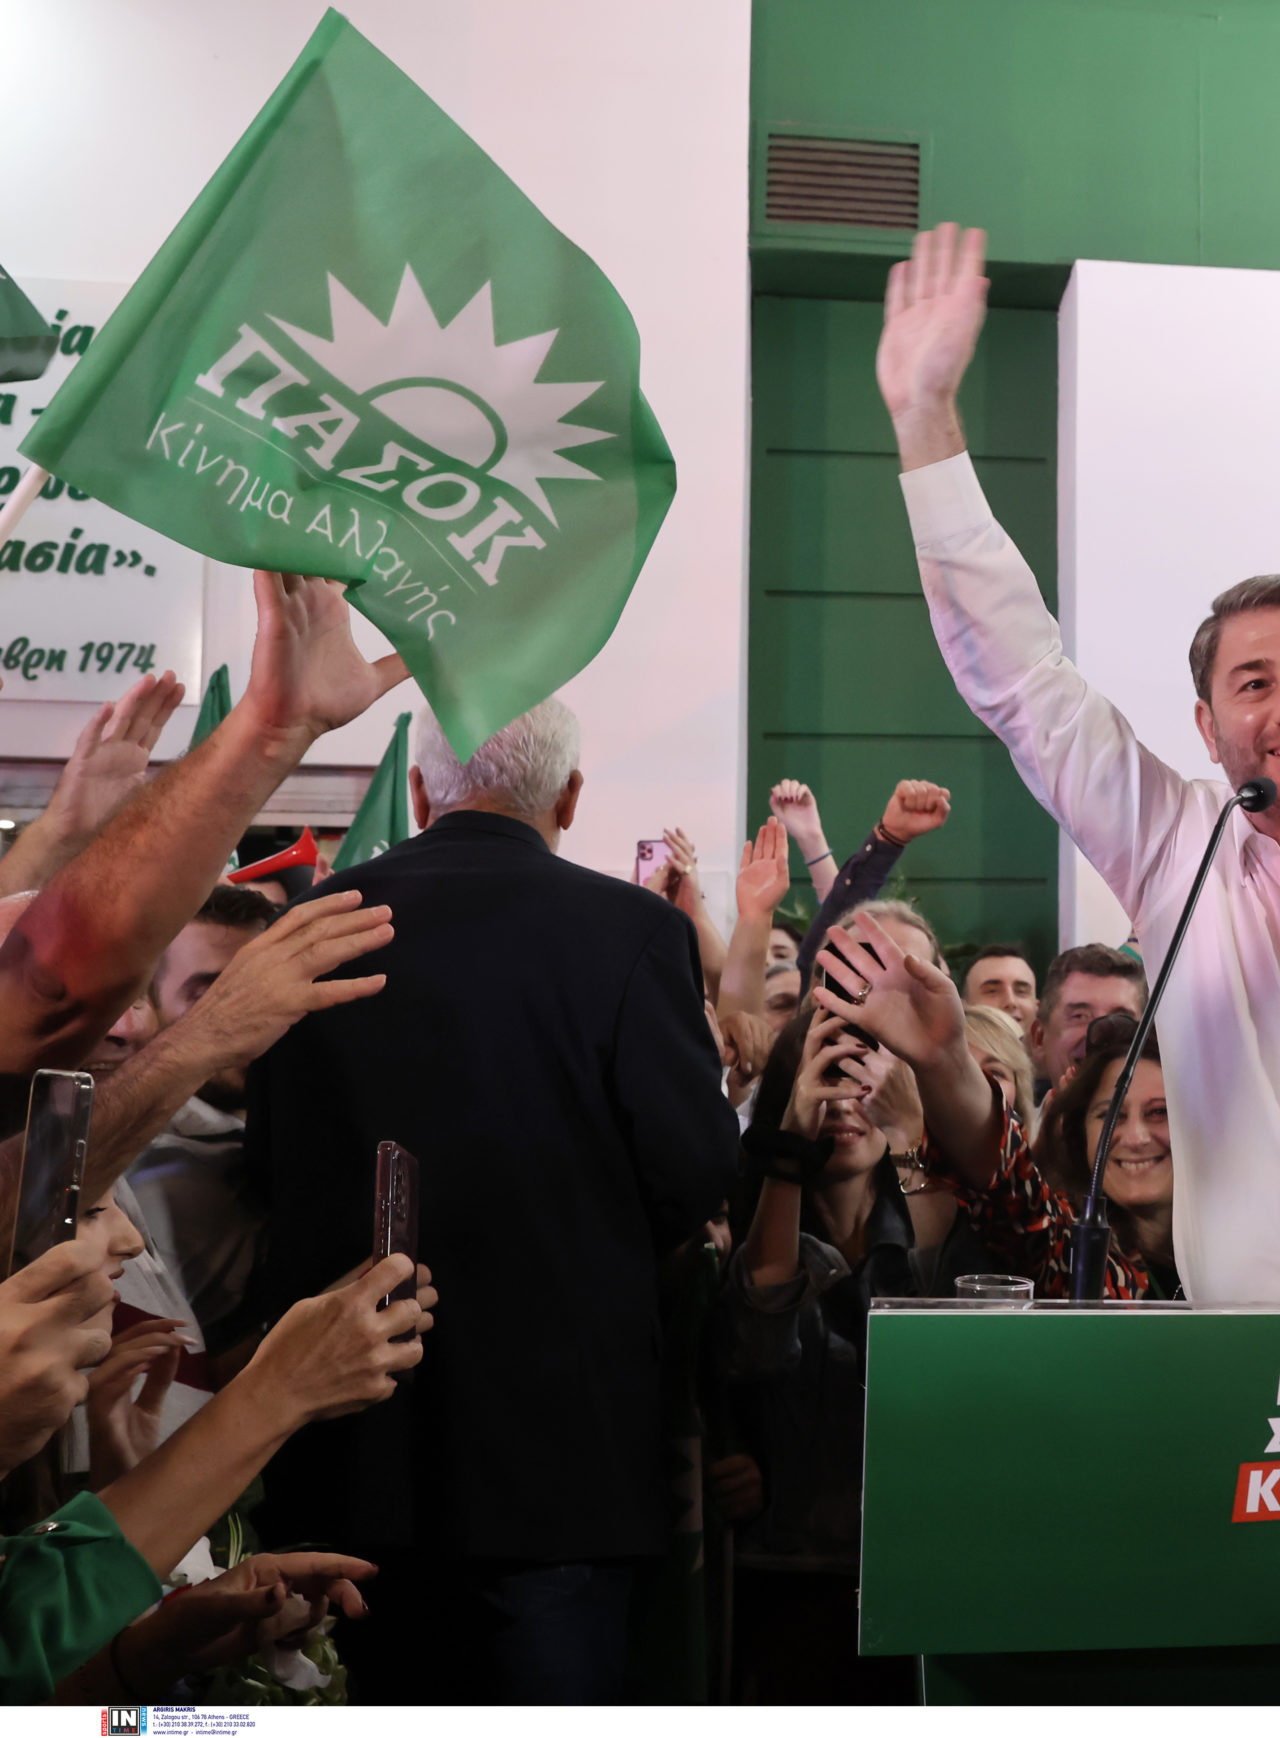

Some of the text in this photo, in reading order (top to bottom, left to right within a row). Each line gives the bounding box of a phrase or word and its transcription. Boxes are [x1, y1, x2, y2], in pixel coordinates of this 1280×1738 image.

[146, 411, 295, 525] Κίνημα
[194, 322, 547, 587] ΠΑΣΟΚ
[79, 640, 157, 675] 1974
